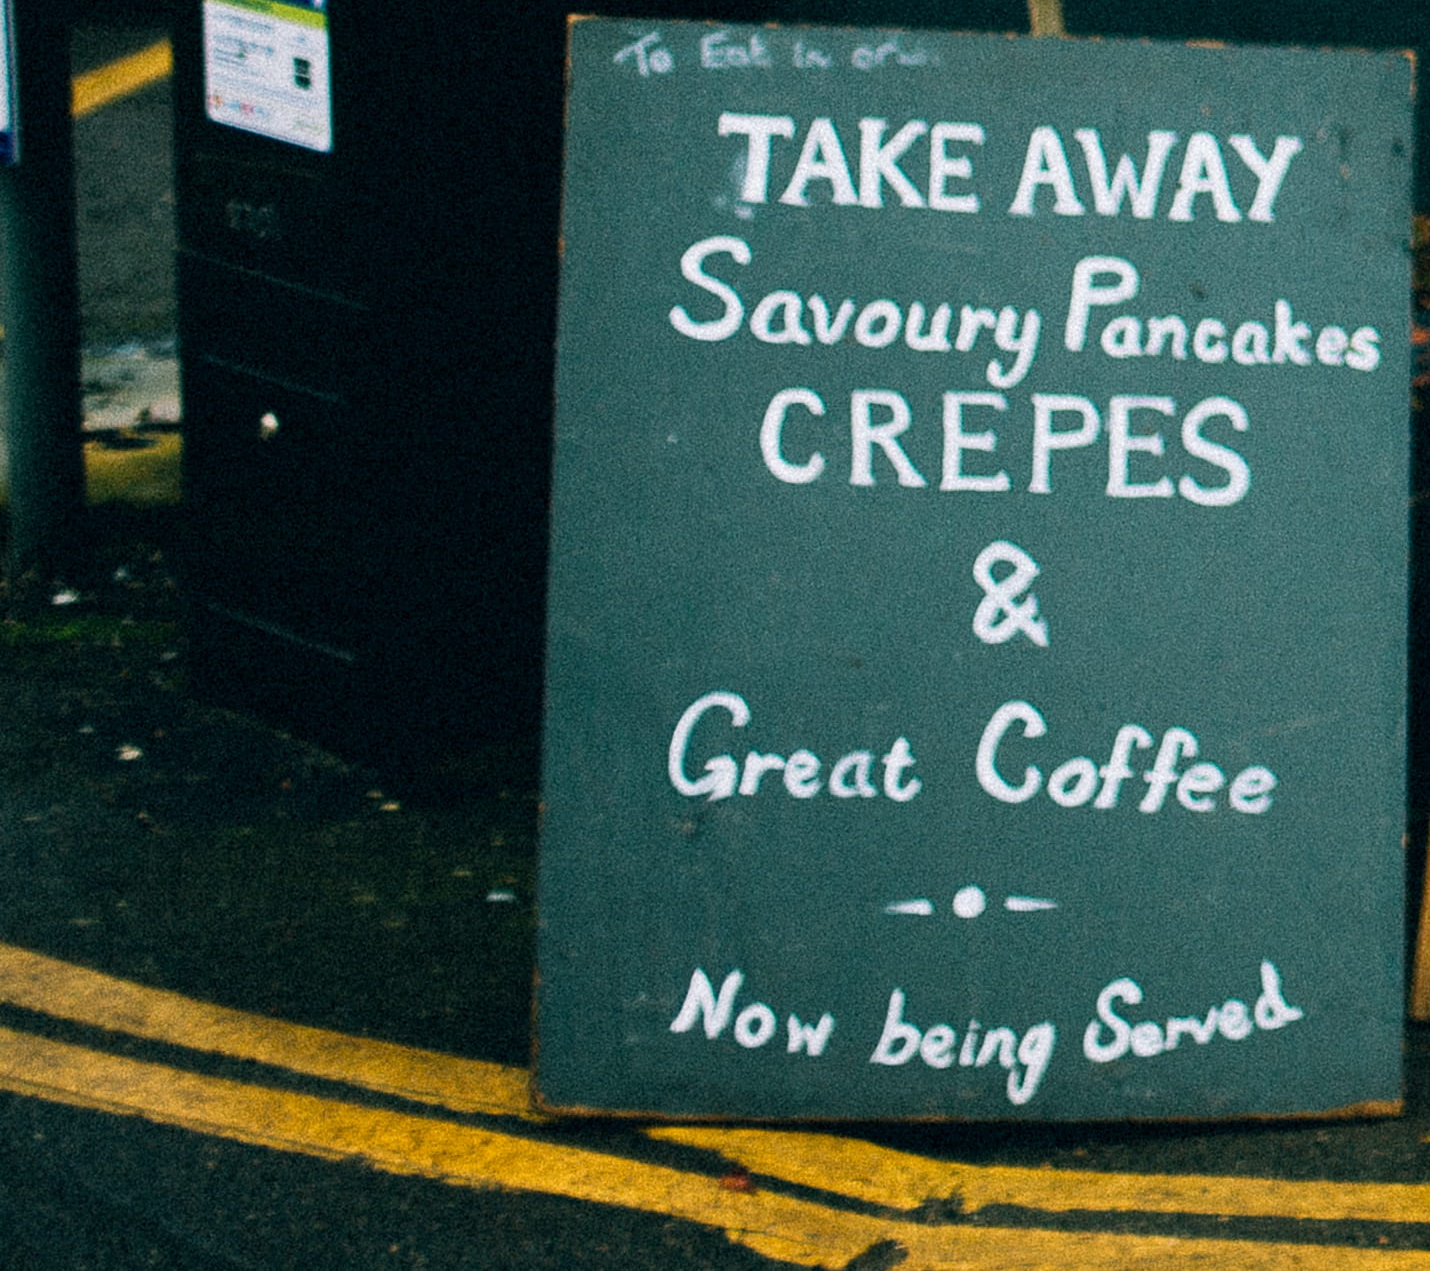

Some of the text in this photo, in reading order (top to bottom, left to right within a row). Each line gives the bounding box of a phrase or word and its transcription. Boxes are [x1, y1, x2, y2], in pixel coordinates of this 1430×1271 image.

[613, 30, 674, 77] To
[718, 112, 1303, 223] TAKE AWAY
[669, 235, 1382, 389] Savoury Pancakes
[759, 387, 1252, 507] CREPES
[973, 540, 1050, 648] &
[667, 691, 1279, 814] Great Coffee
[669, 959, 1304, 1106] Now being Served
